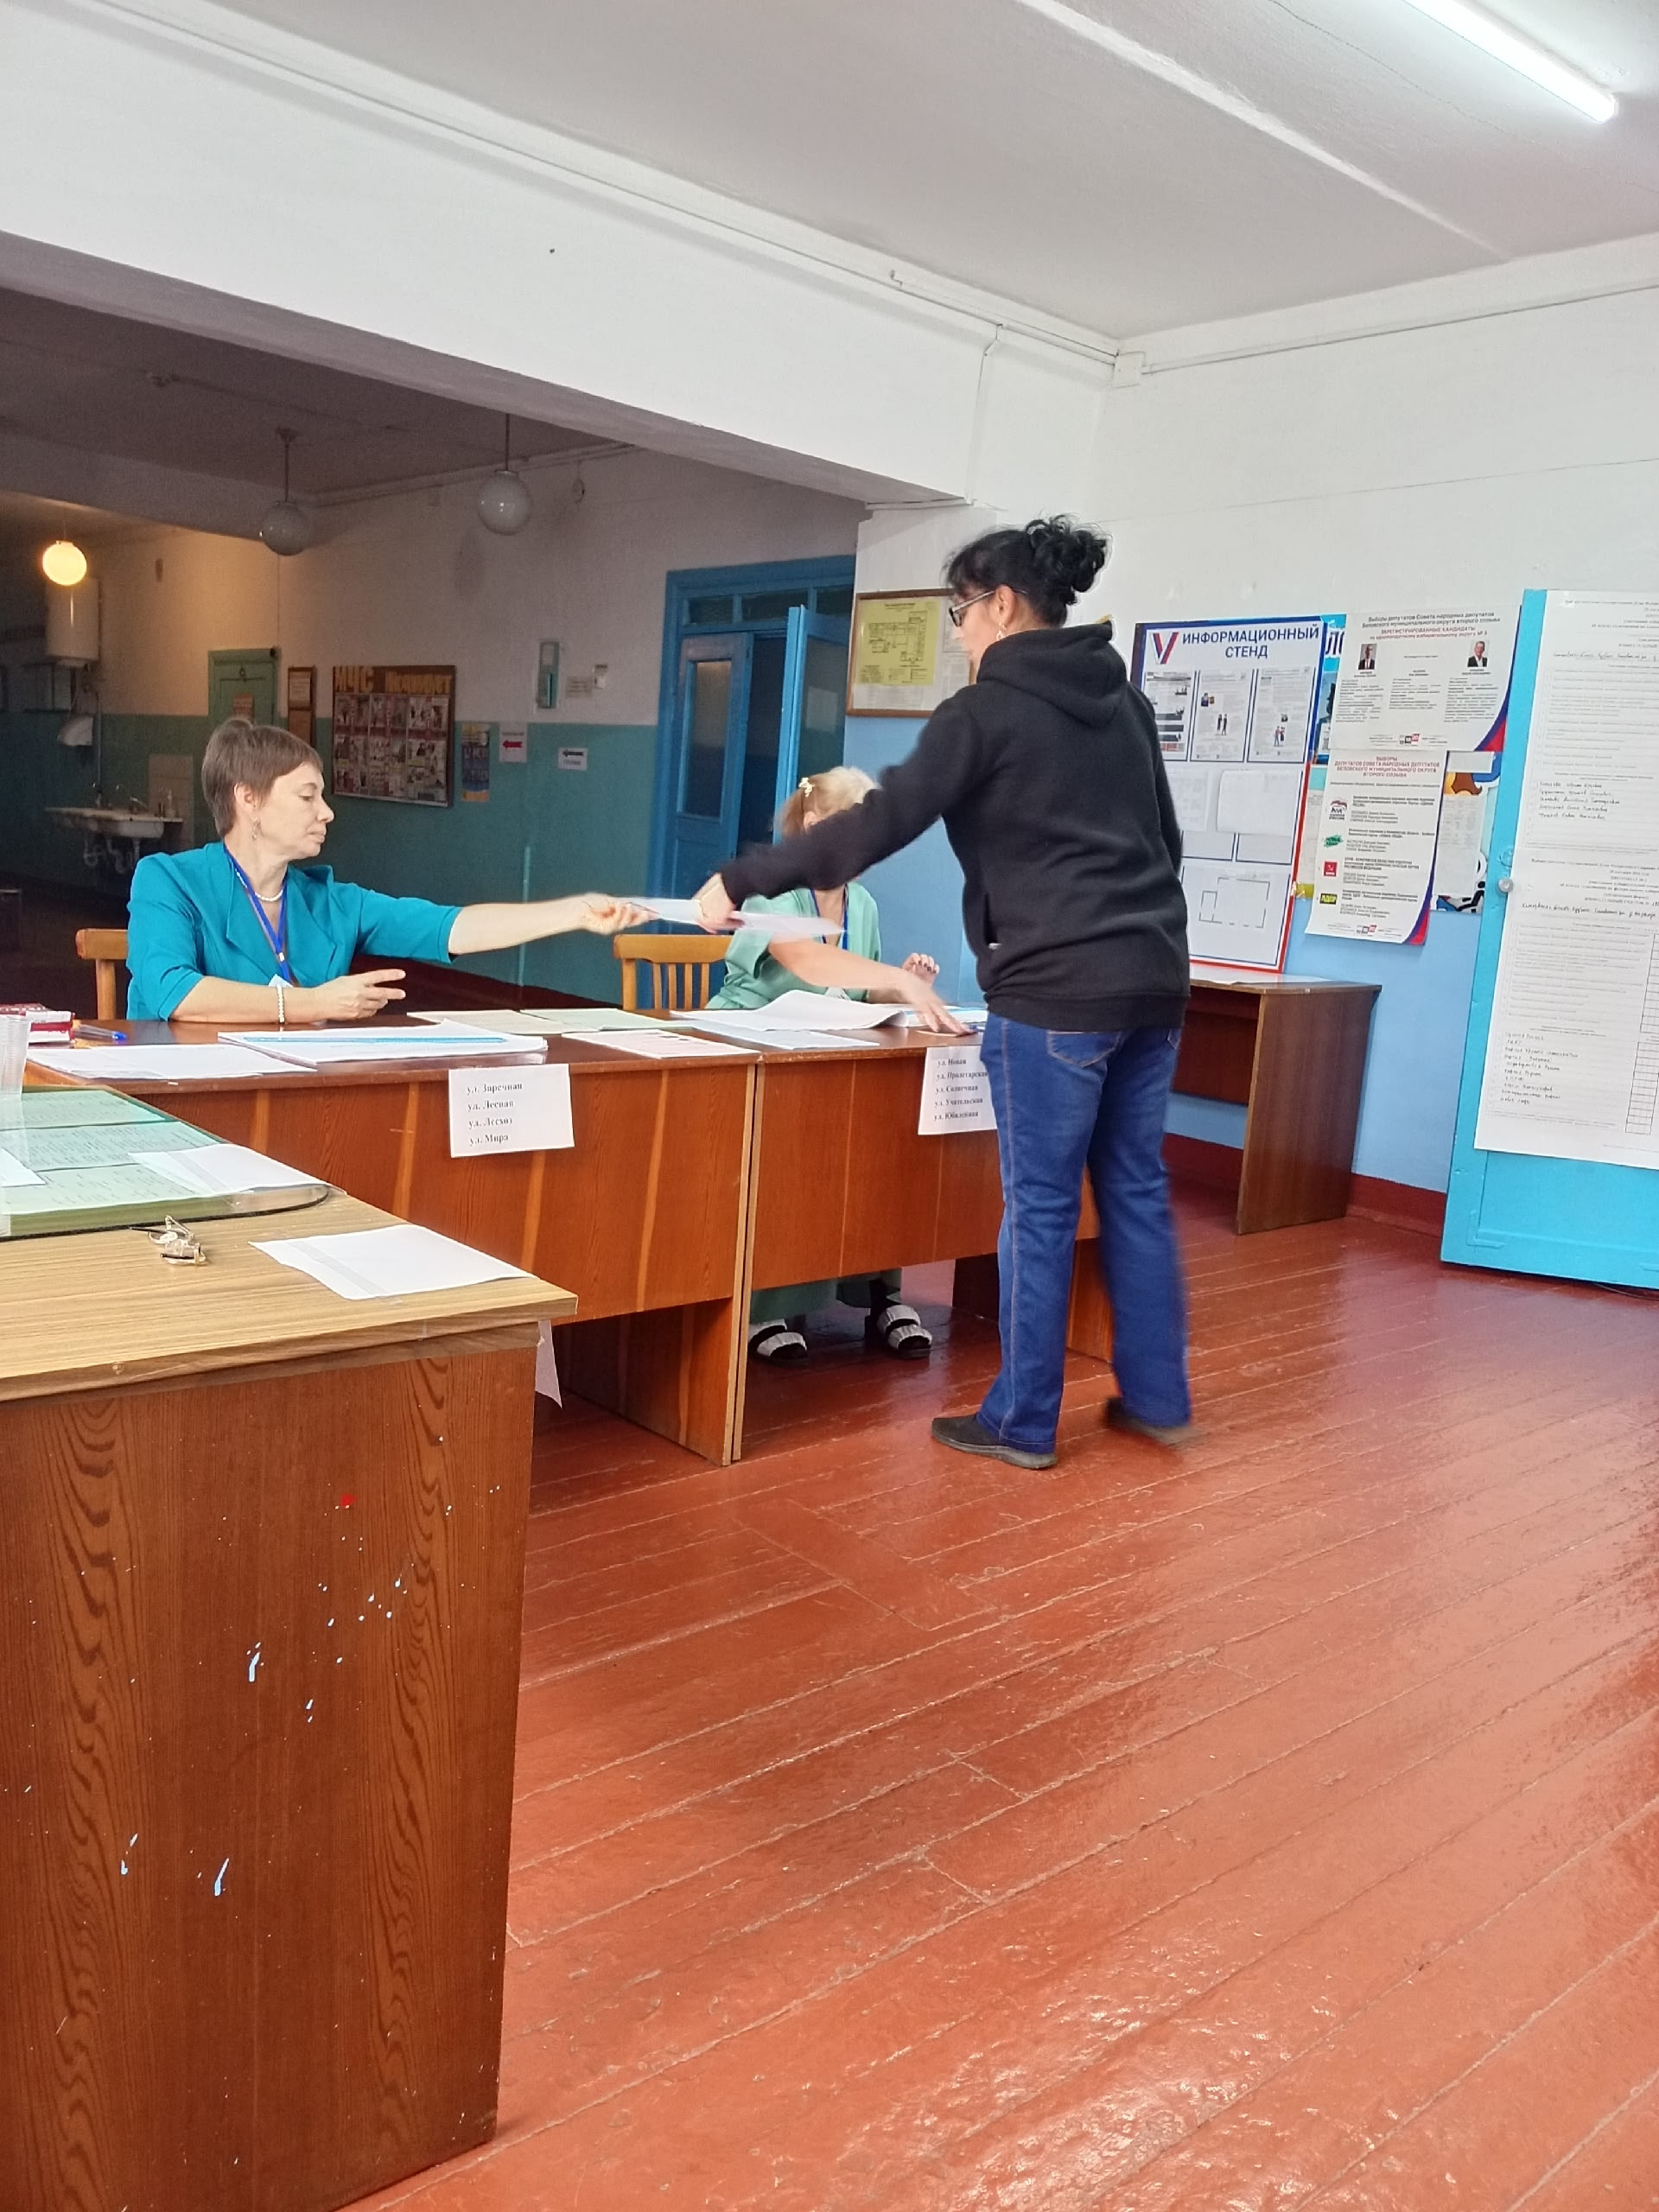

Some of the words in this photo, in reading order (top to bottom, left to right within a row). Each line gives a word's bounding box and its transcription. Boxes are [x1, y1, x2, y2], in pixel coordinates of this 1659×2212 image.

[1182, 624, 1319, 645] ИНФОРМАЦИОННЫЙ
[1224, 645, 1268, 659] СТЕНД
[334, 665, 374, 694] МЧС
[947, 1071, 988, 1080] Пролетарская
[482, 1083, 523, 1093] Заречная
[482, 1100, 514, 1109] Лесная
[945, 1097, 983, 1106] Учительская
[483, 1117, 512, 1127] Лесхоз
[485, 1134, 509, 1144] Мира
